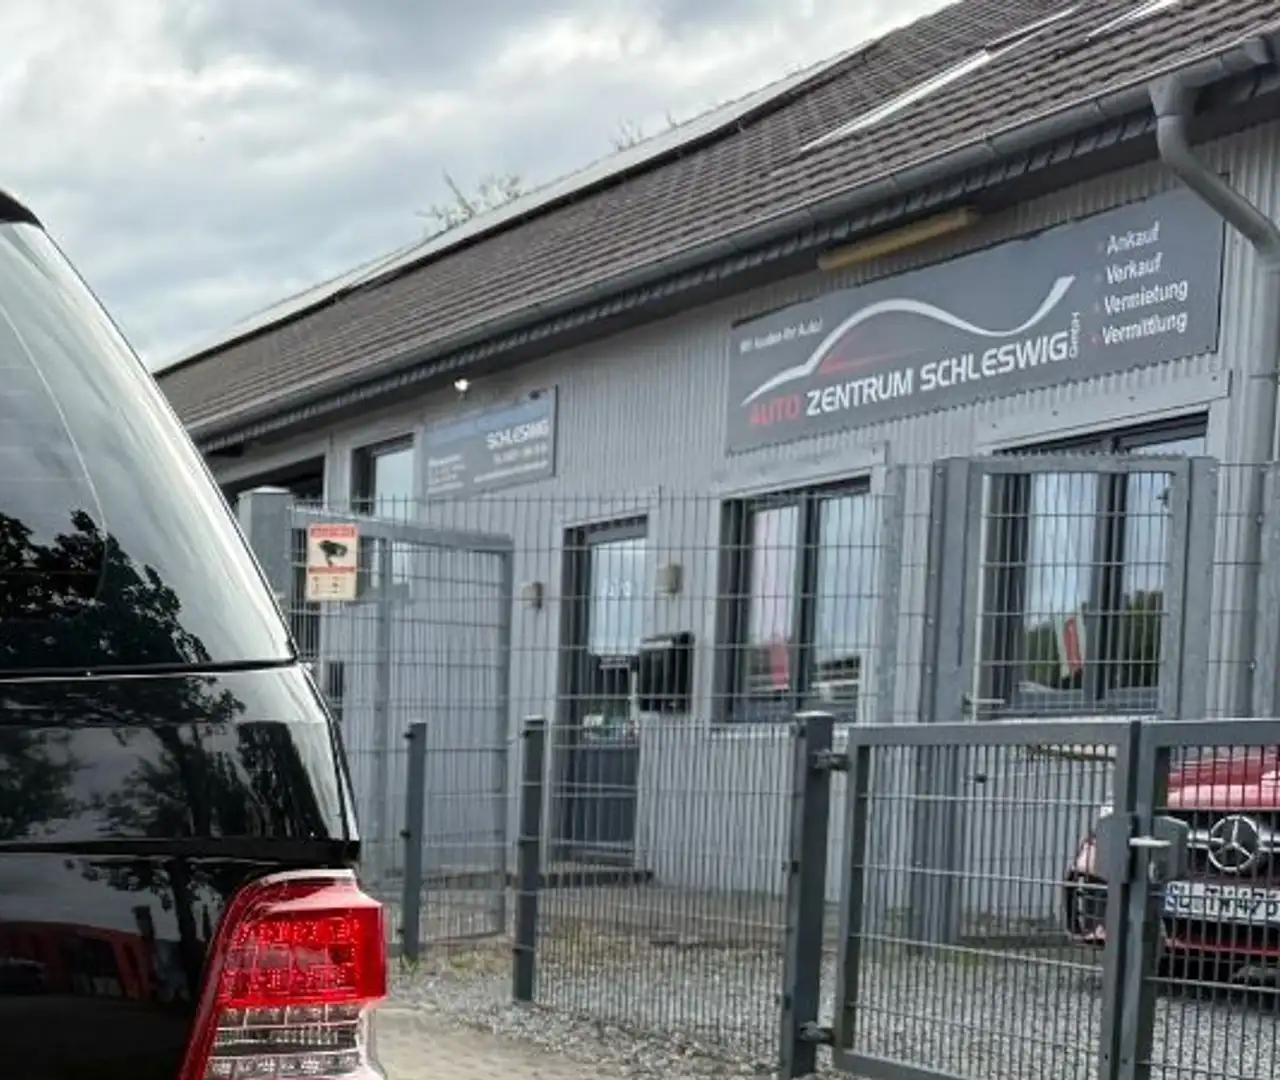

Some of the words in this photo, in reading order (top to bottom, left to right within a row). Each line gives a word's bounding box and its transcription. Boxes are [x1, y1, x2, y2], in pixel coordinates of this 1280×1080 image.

[1107, 221, 1159, 255] Ankauf
[1106, 252, 1163, 284] Verkauf
[1104, 280, 1188, 315] Vermietung
[1102, 312, 1188, 345] Vermittlung
[748, 394, 801, 425] AUTO
[805, 367, 913, 417] ZENTRUM
[919, 329, 1069, 392] SCHLESWIG
